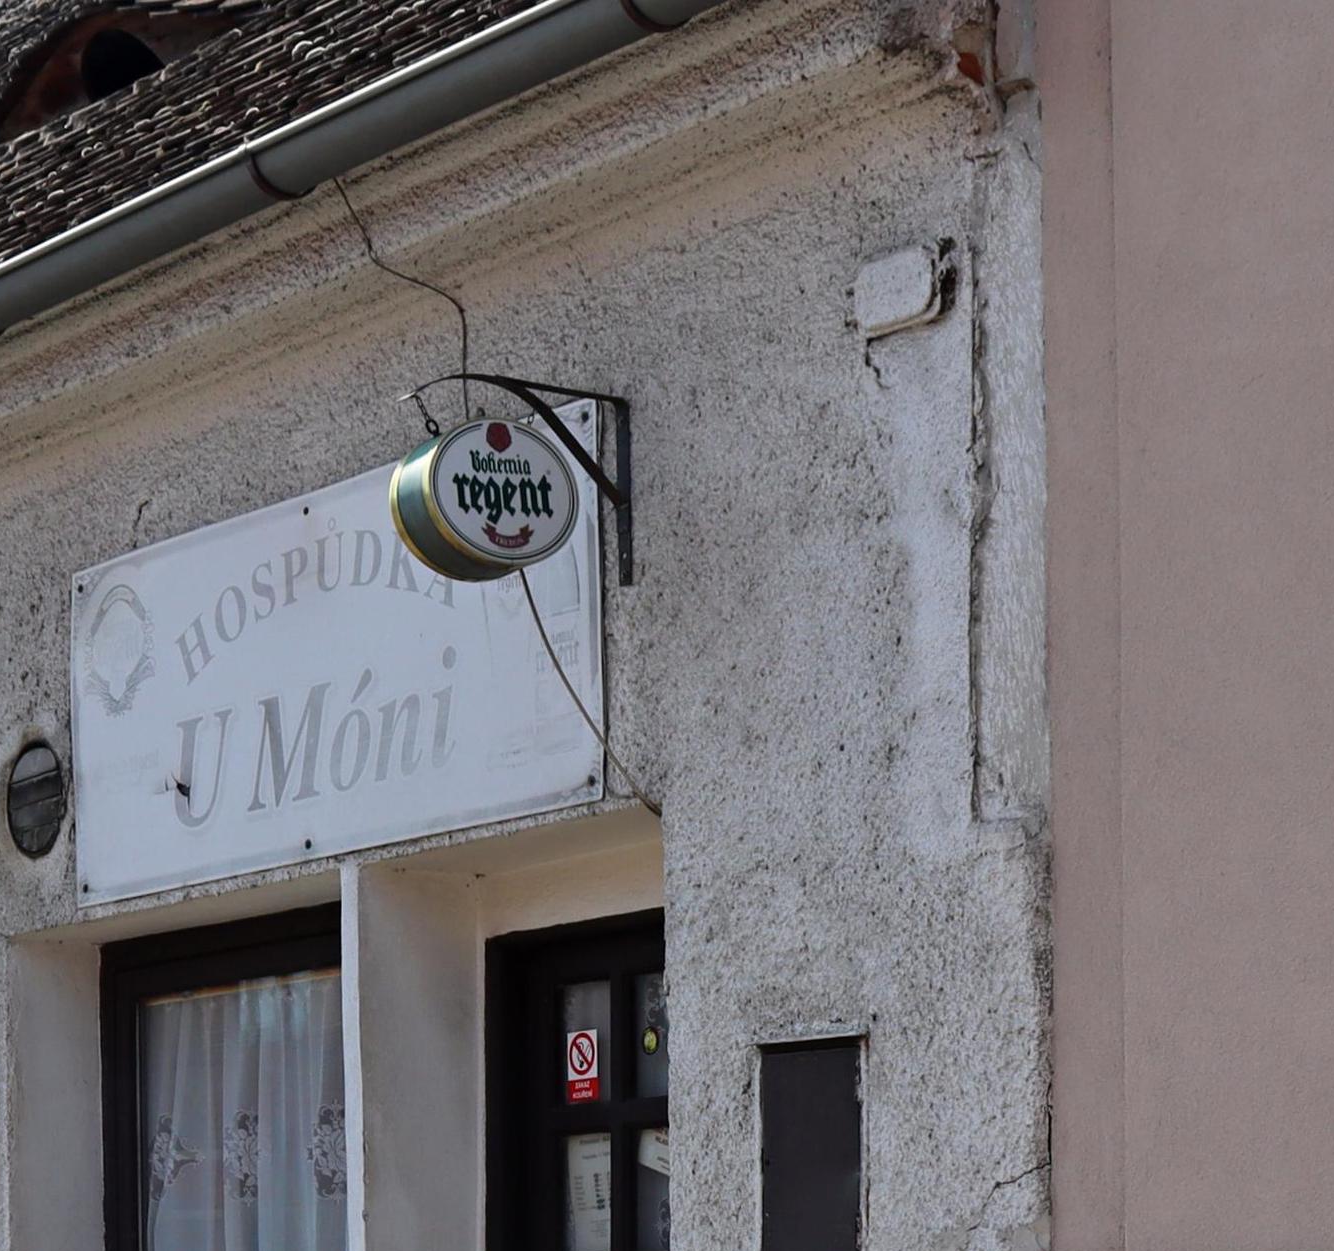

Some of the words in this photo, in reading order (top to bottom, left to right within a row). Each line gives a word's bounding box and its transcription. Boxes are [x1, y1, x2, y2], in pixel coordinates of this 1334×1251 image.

[469, 449, 532, 475] Bohemia
[452, 472, 554, 525] regent
[174, 708, 233, 828] U
[247, 645, 457, 812] Móni
